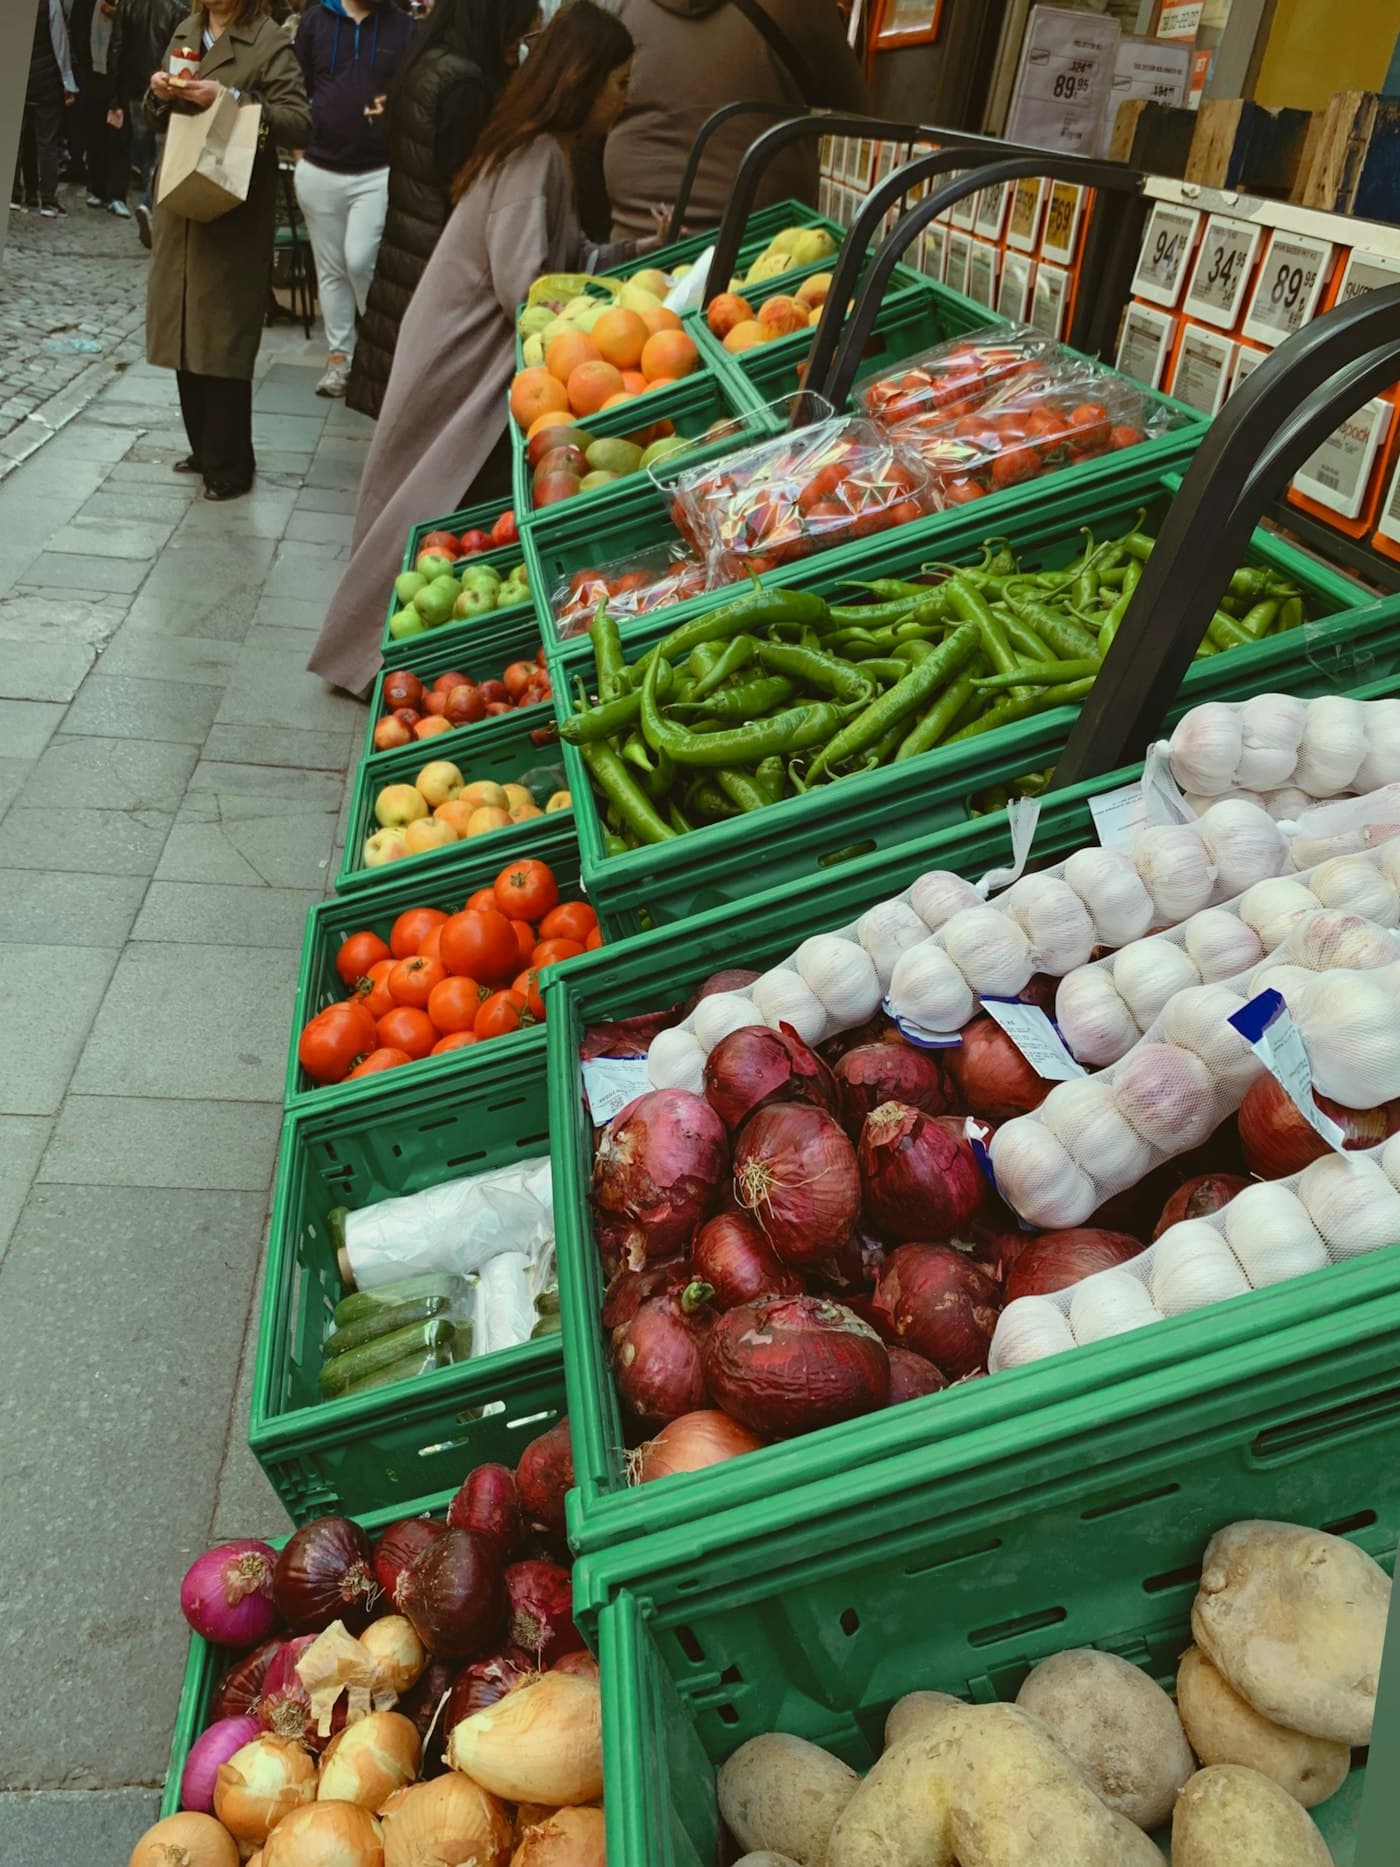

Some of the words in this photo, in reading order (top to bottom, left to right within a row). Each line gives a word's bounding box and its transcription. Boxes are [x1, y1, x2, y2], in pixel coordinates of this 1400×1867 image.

[1153, 230, 1179, 266] 94
[1207, 246, 1237, 287] 34
[1271, 264, 1304, 309] 89
